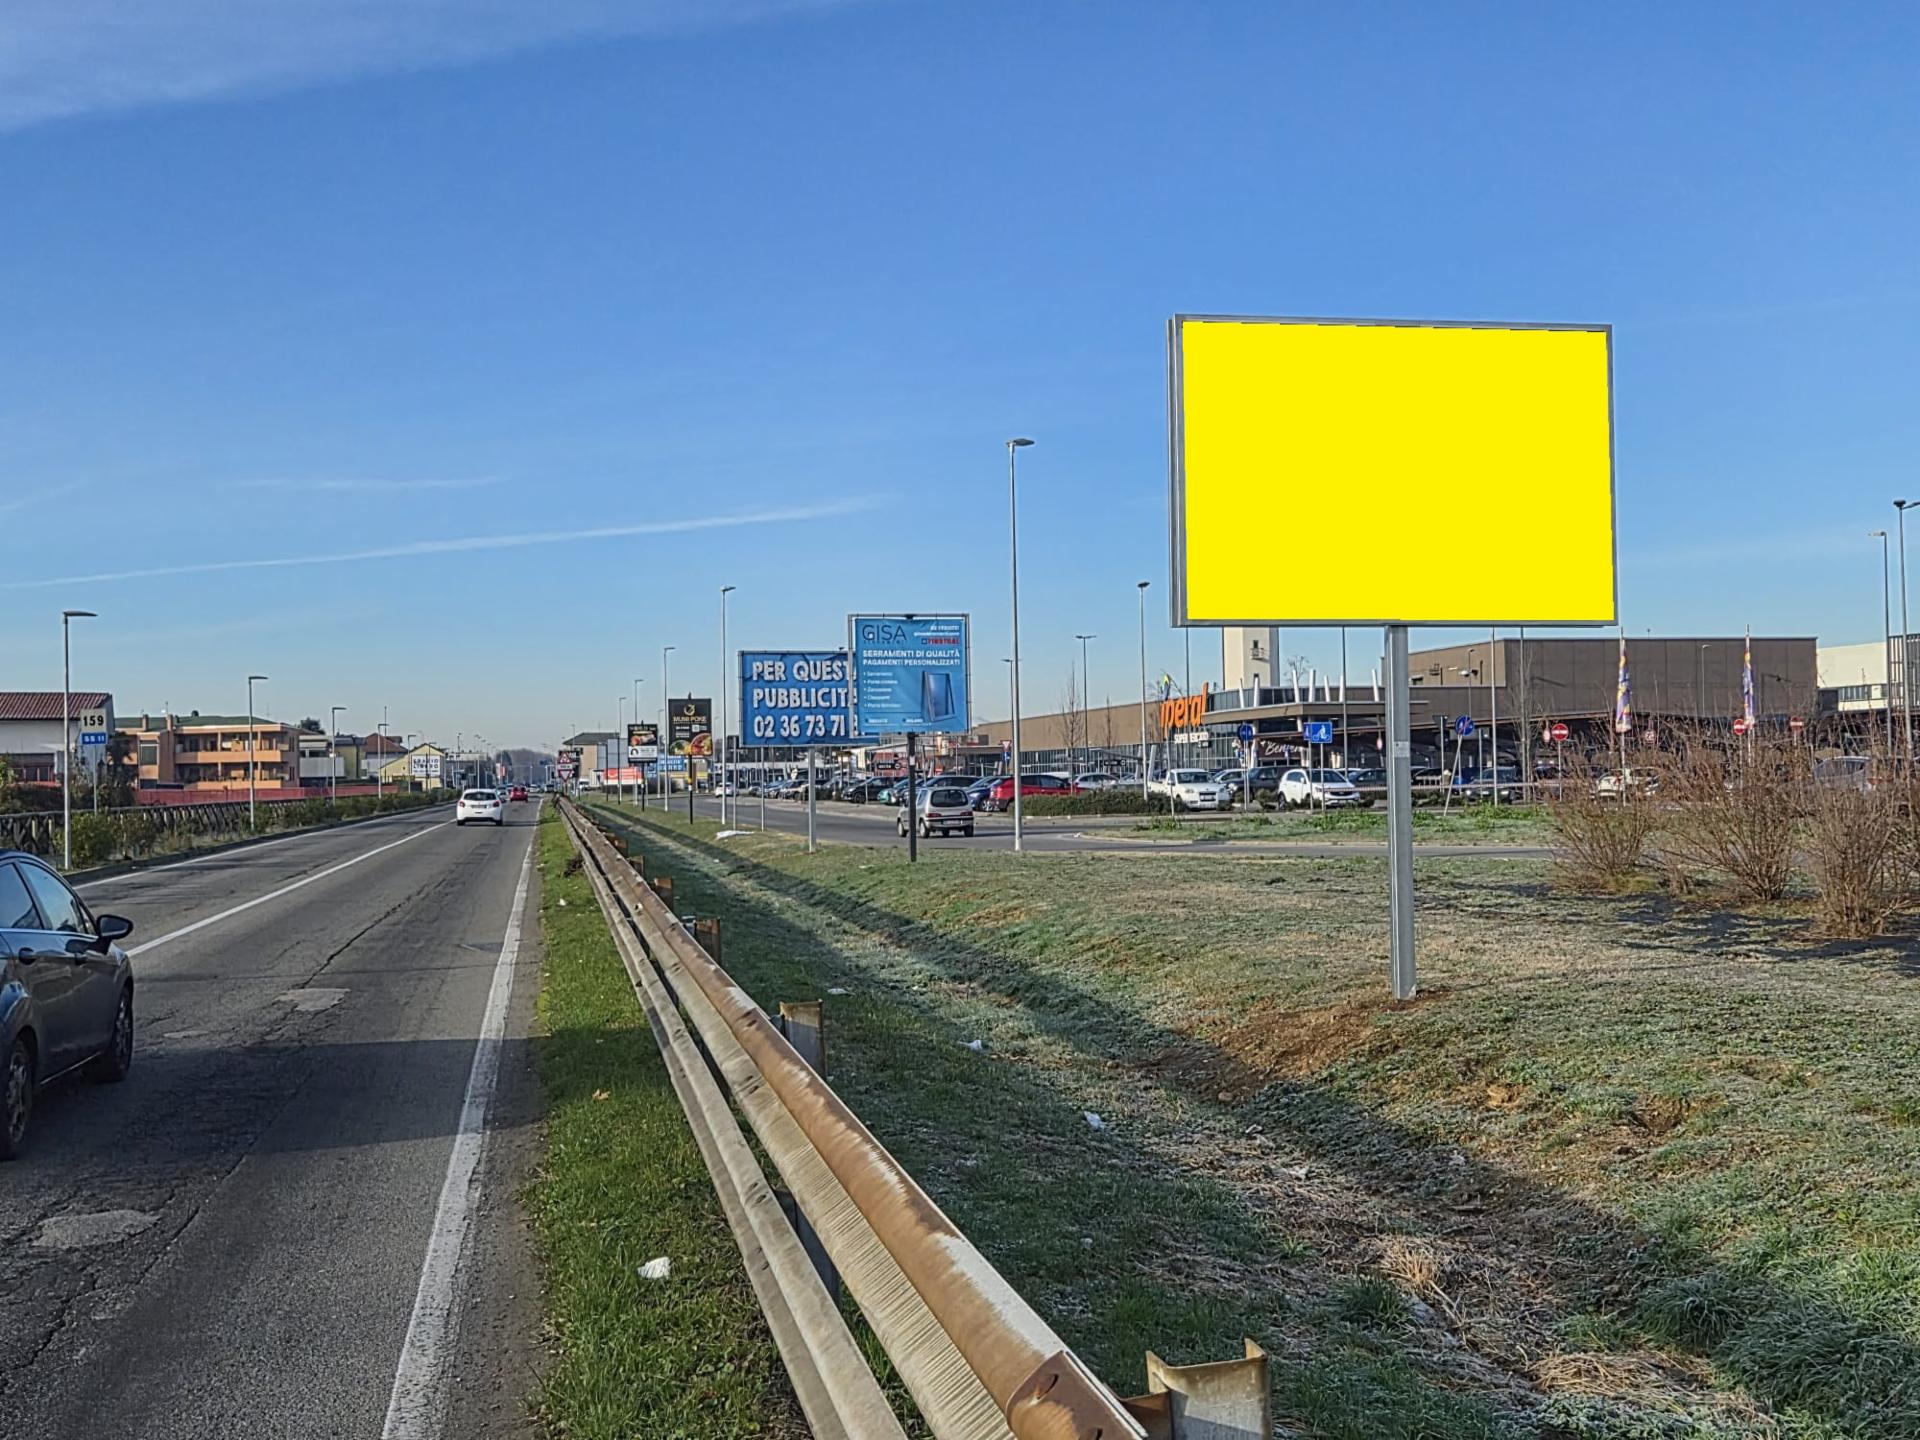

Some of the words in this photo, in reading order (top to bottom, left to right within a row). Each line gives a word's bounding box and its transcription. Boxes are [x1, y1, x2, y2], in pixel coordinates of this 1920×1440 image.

[862, 624, 907, 641] GISA
[863, 650, 914, 658] SERRAMENTI
[916, 650, 924, 658] DI
[925, 648, 960, 658] QUALITÀ
[752, 660, 786, 681] PER
[793, 660, 857, 682] QUEST
[83, 715, 104, 726] 159
[754, 715, 775, 737] 02
[780, 715, 800, 737] 36
[805, 715, 826, 737] 73
[830, 715, 845, 737] 71
